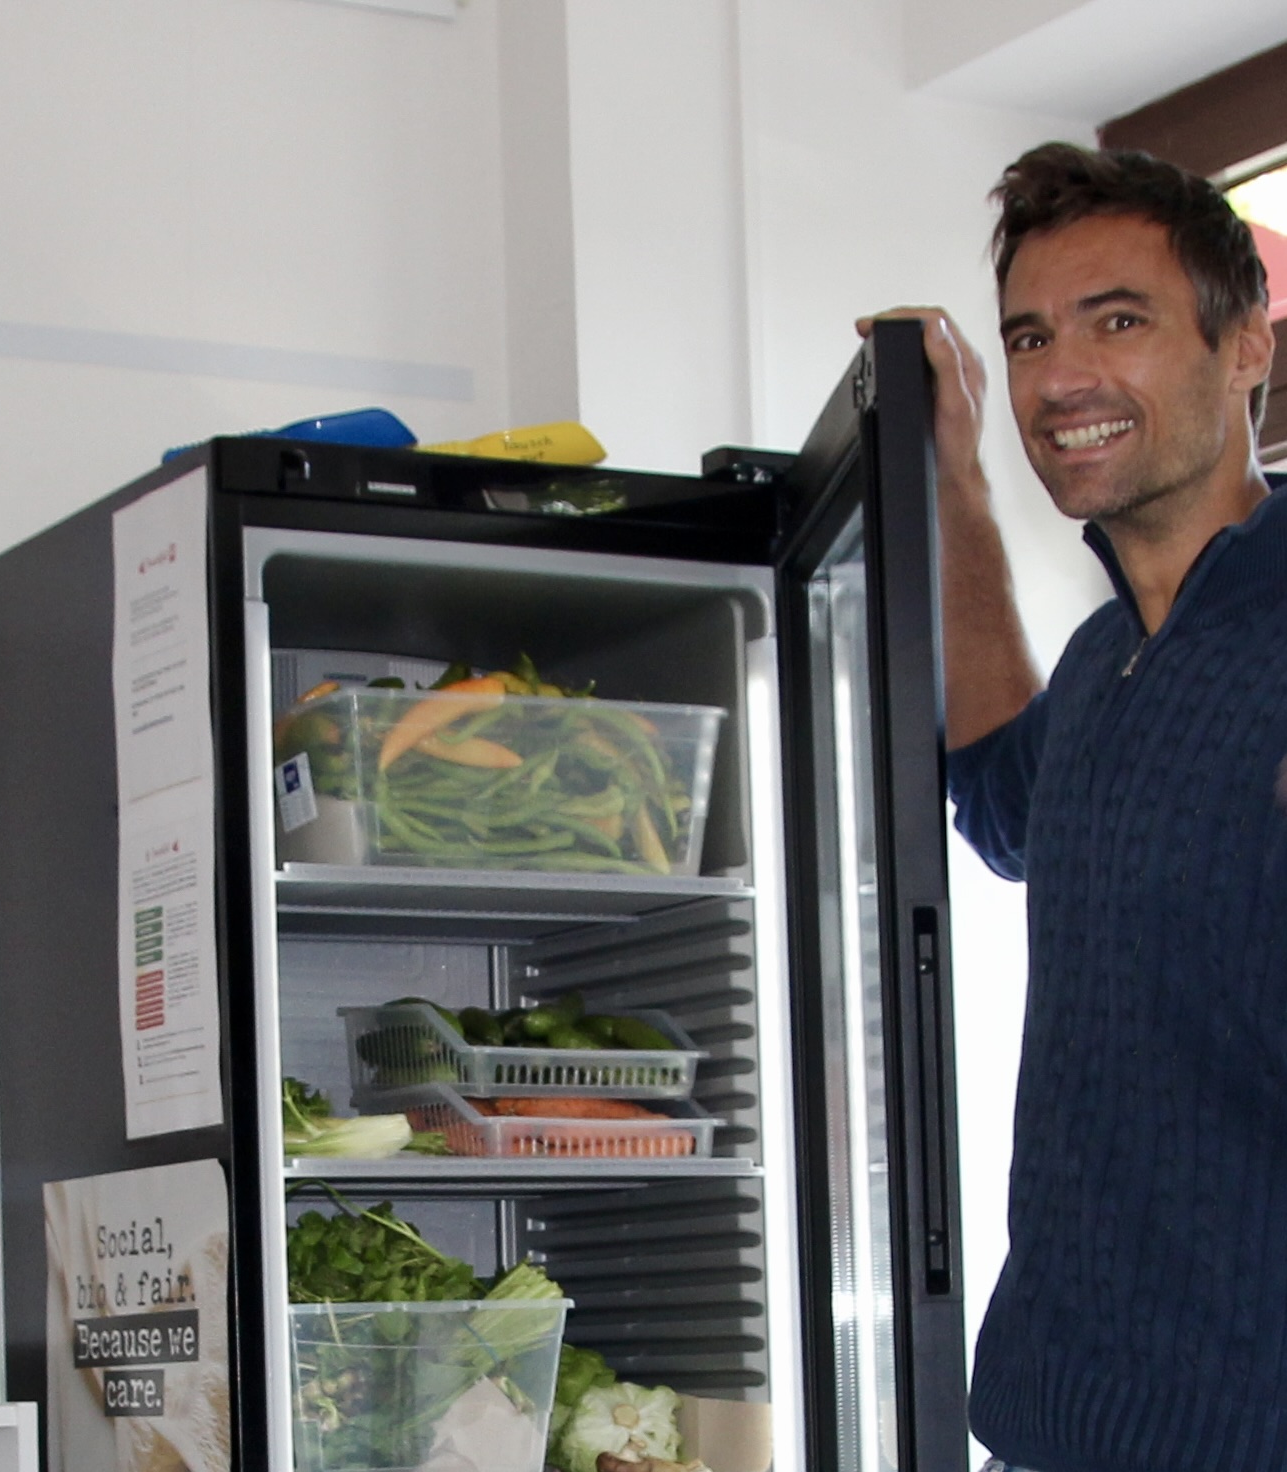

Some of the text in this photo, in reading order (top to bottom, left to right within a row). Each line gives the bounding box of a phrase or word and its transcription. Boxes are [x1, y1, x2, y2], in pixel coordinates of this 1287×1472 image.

[97, 1217, 173, 1259] Social,
[76, 1268, 196, 1309] bio & fair.
[77, 1323, 196, 1360] Because we
[106, 1377, 162, 1409] care.
